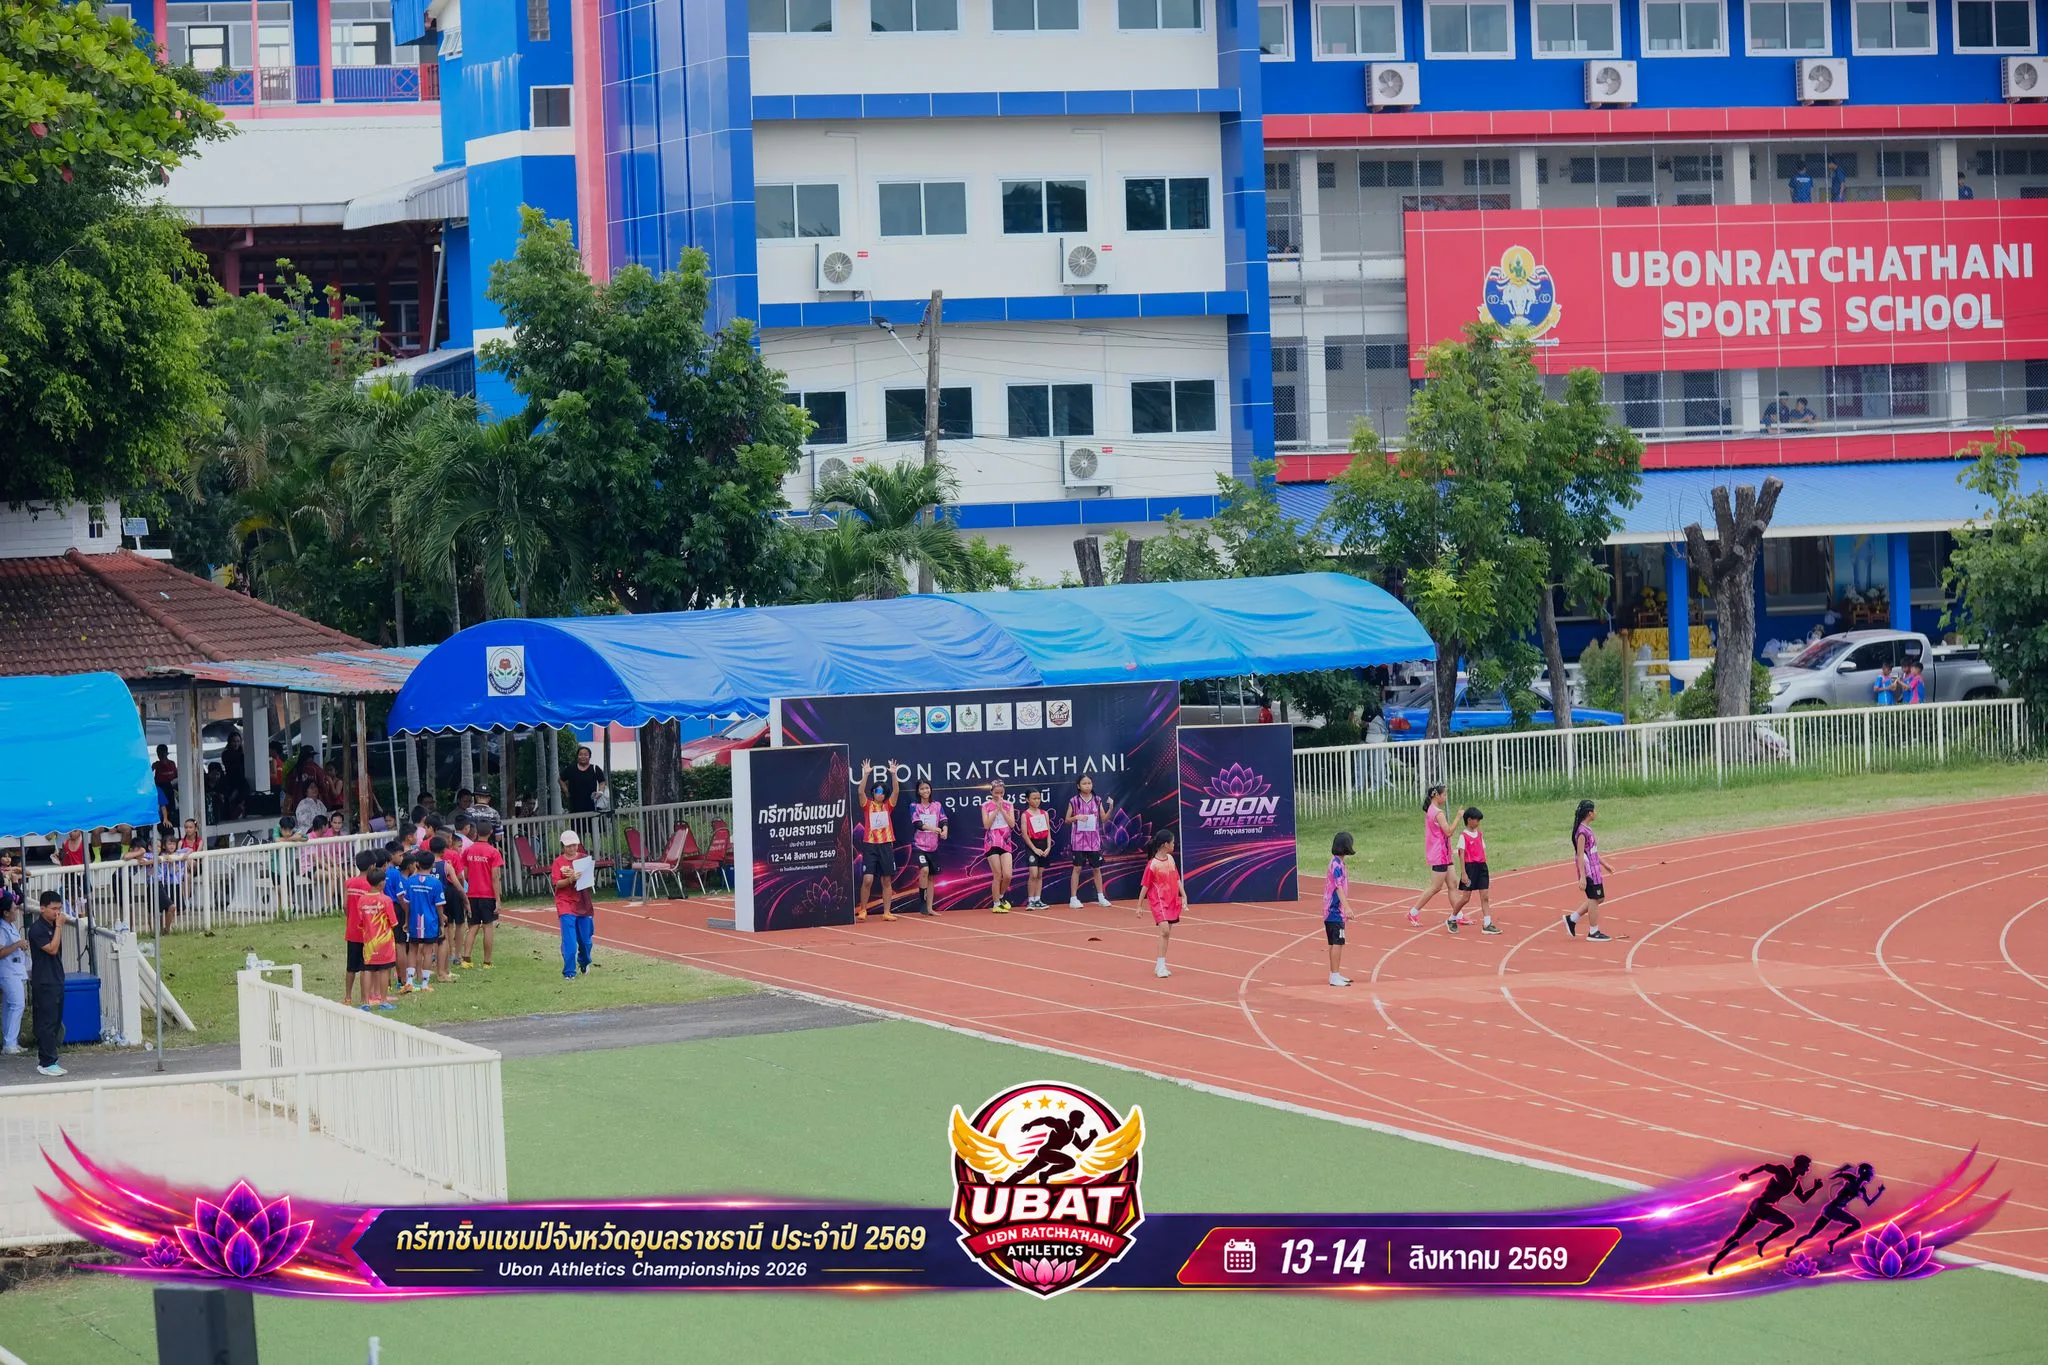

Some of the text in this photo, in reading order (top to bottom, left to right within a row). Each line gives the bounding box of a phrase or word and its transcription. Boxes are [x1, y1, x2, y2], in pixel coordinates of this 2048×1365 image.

[1611, 243, 2033, 288] UBONRATCHATHANI
[1663, 293, 2005, 338] SPORTS SCHOOL
[848, 753, 1127, 785] UBON RATCHATHANI
[758, 799, 846, 825] กรีฑาชิงแชมป์
[1199, 795, 1281, 817] UBON
[769, 820, 834, 841] จ.อุบลราชธานี
[1200, 814, 1278, 829] ATHLETICS
[819, 849, 836, 859] 2569
